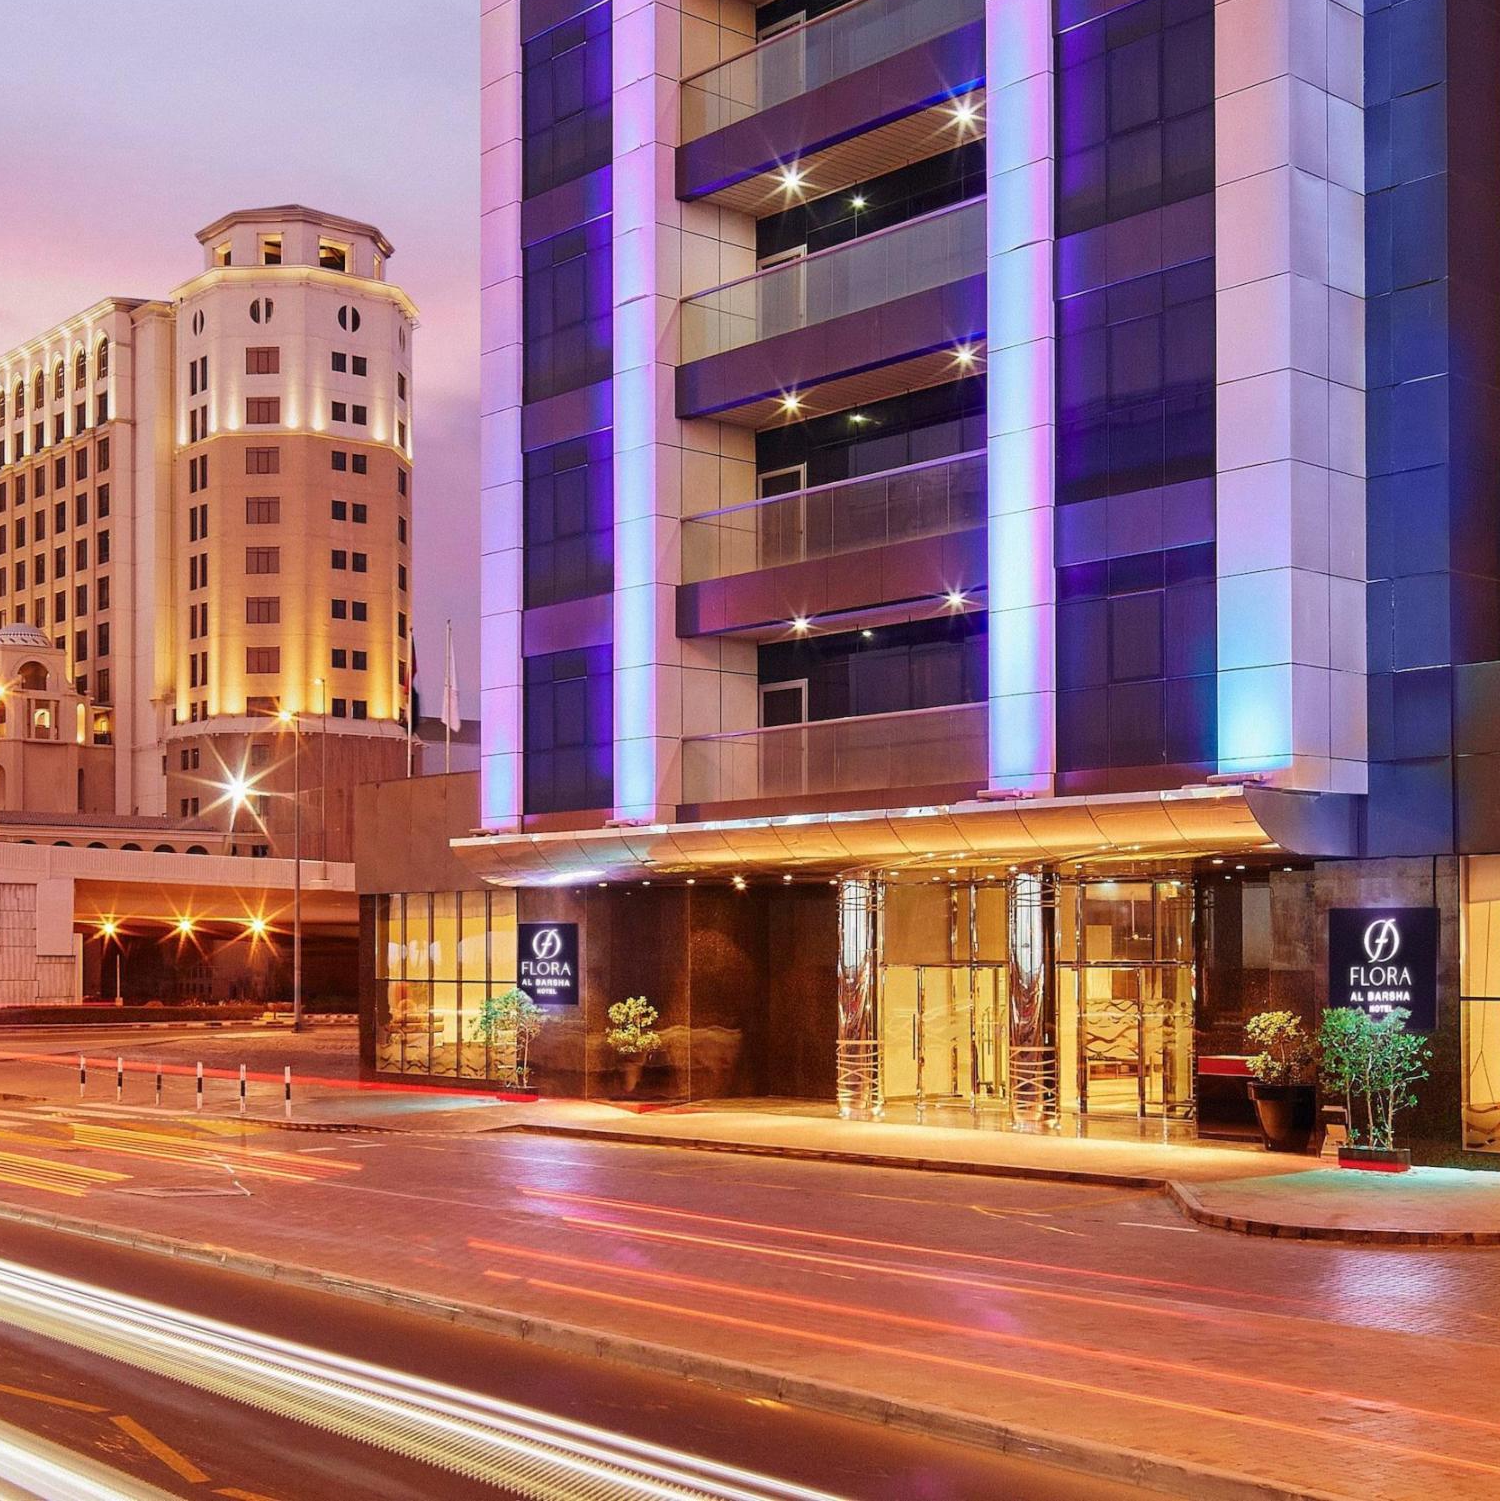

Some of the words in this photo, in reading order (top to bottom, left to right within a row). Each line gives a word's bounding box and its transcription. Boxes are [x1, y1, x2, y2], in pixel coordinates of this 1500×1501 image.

[521, 961, 571, 975] FLORA
[1350, 966, 1412, 986] FLORA
[535, 979, 570, 987] BARSHA
[1350, 991, 1364, 1001] AL
[1367, 991, 1410, 1001] BARSHA
[1369, 1005, 1393, 1013] HOTEL
